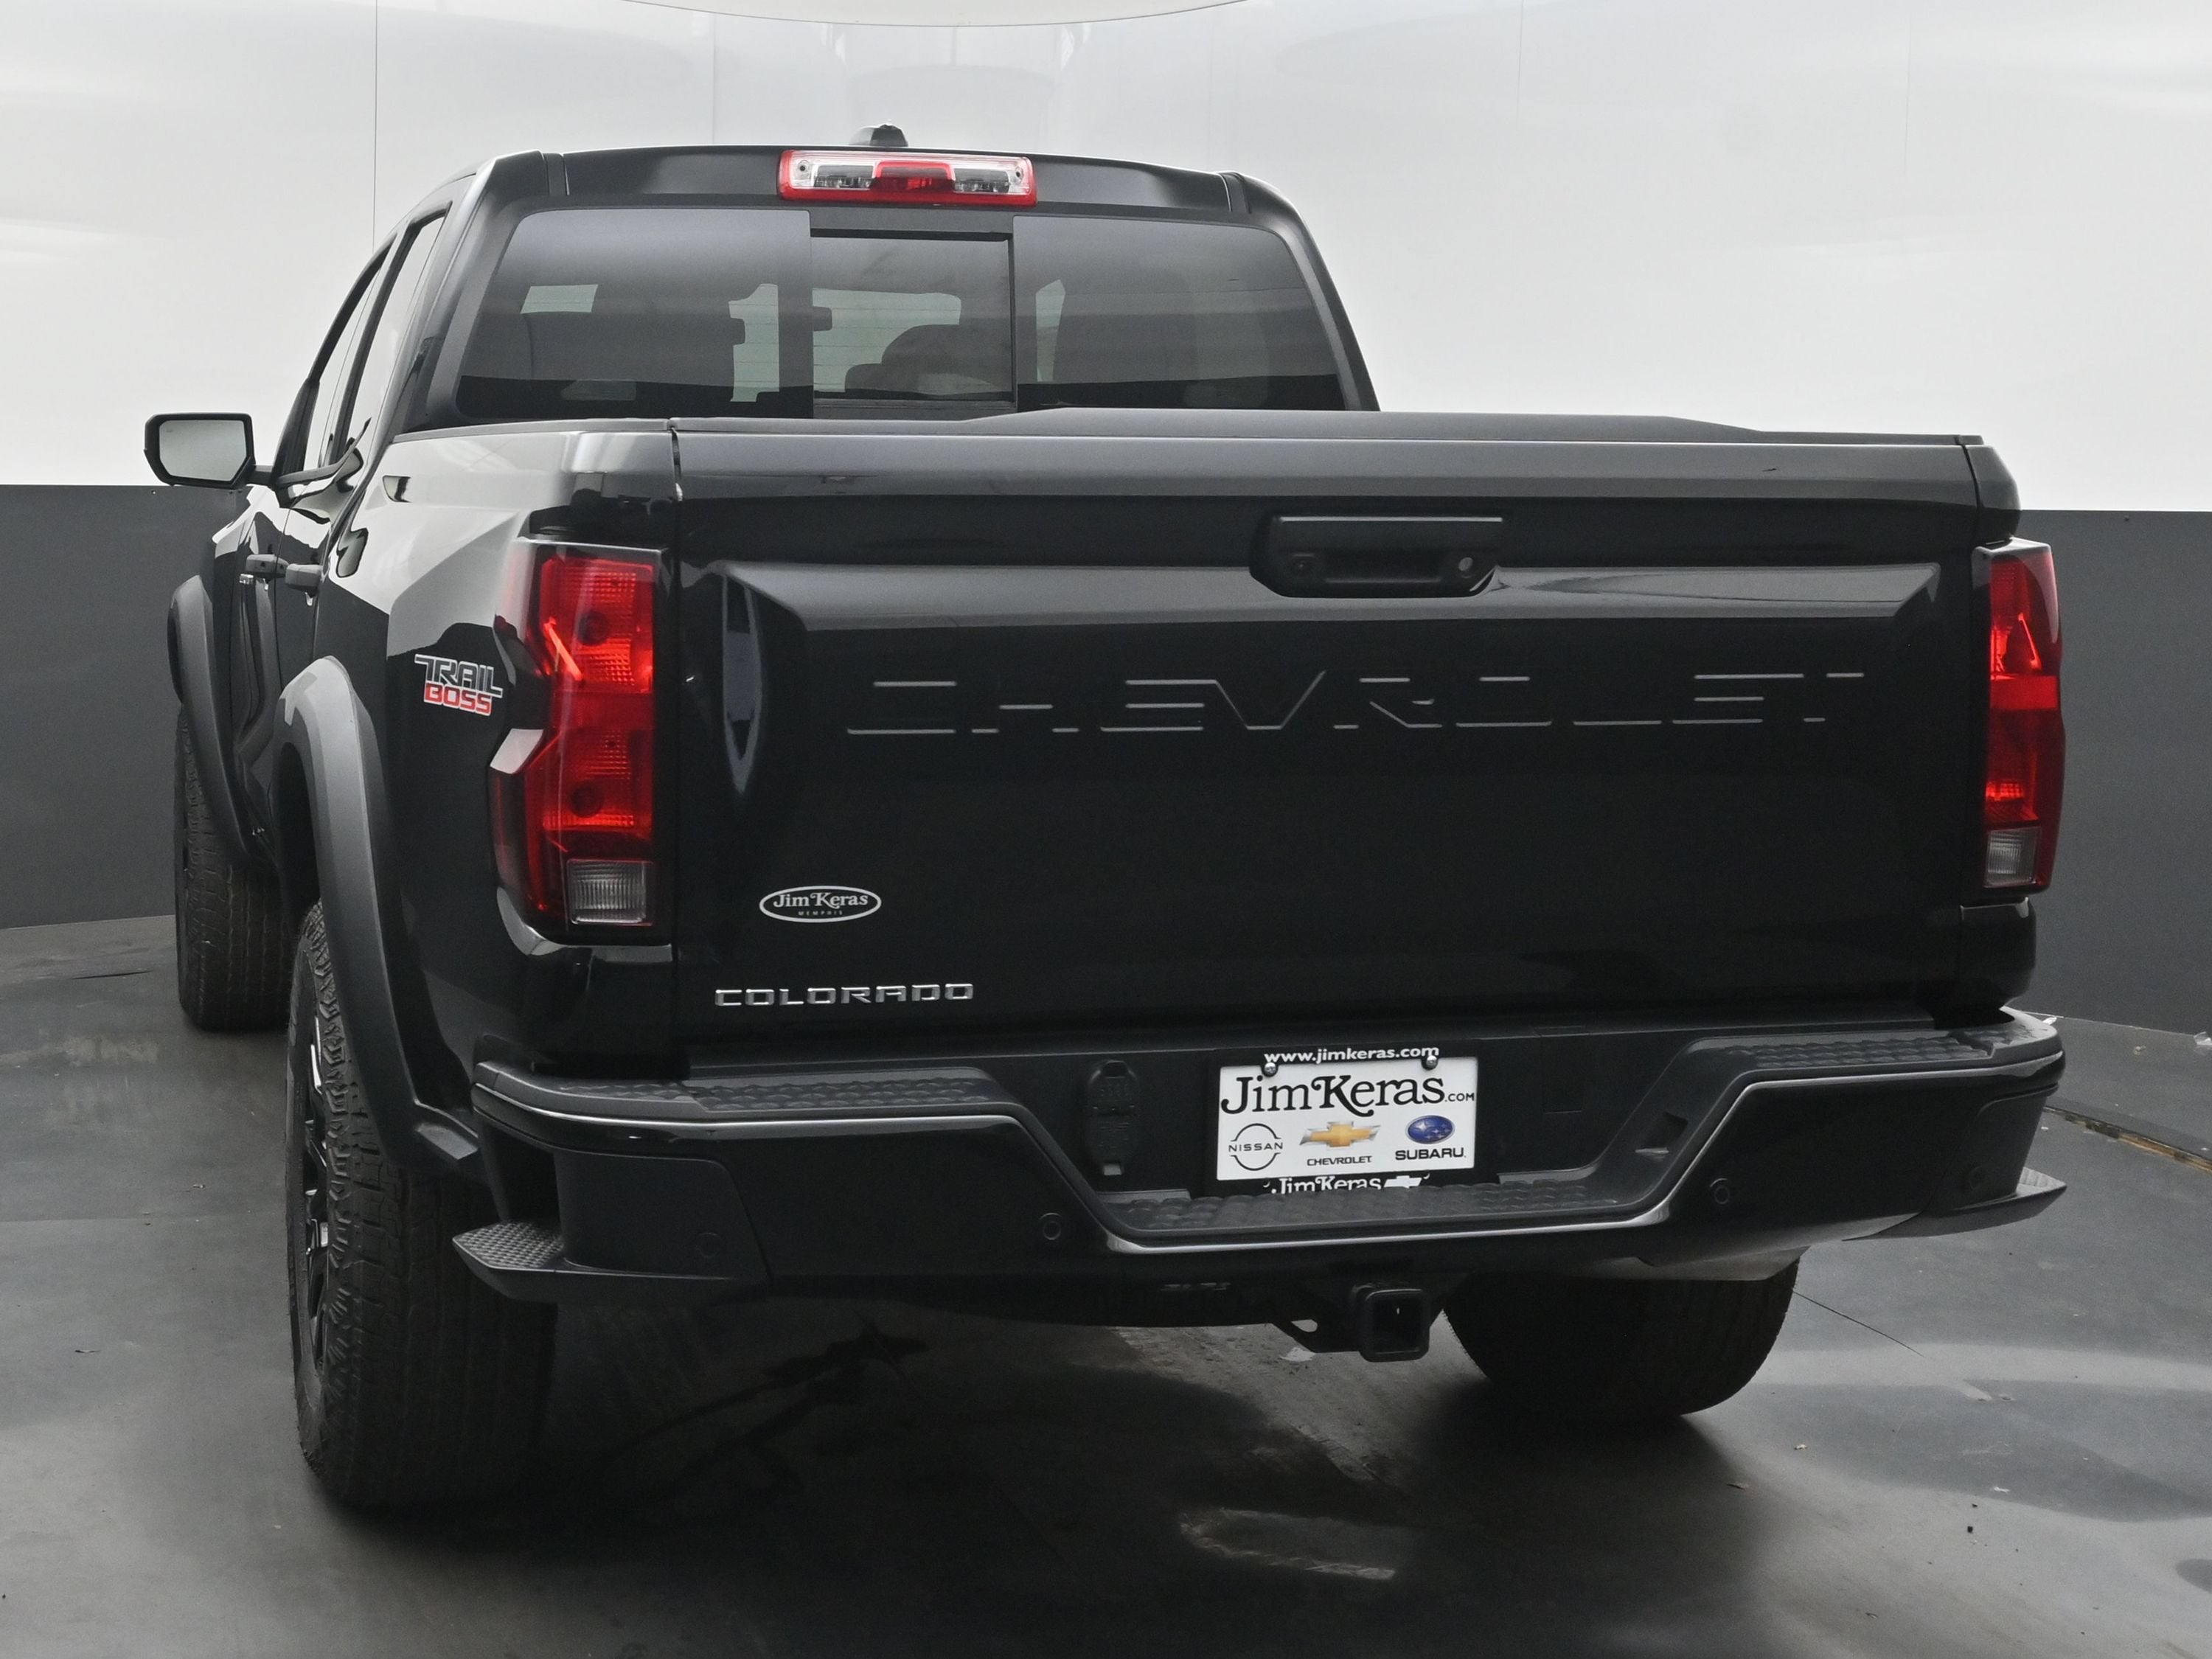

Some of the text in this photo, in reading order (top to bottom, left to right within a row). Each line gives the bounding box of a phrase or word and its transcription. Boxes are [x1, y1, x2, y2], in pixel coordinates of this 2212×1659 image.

[414, 654, 503, 698] TRAIL
[424, 681, 492, 716] BOSS
[847, 669, 1865, 734] CHEVROLET
[714, 983, 973, 1006] COLORADO
[1264, 1047, 1439, 1064] www.jimkeras.com
[1228, 1142, 1284, 1152] NISSAN
[1395, 1147, 1464, 1161] SUBARU
[1307, 1155, 1372, 1166] CHEVROLET
